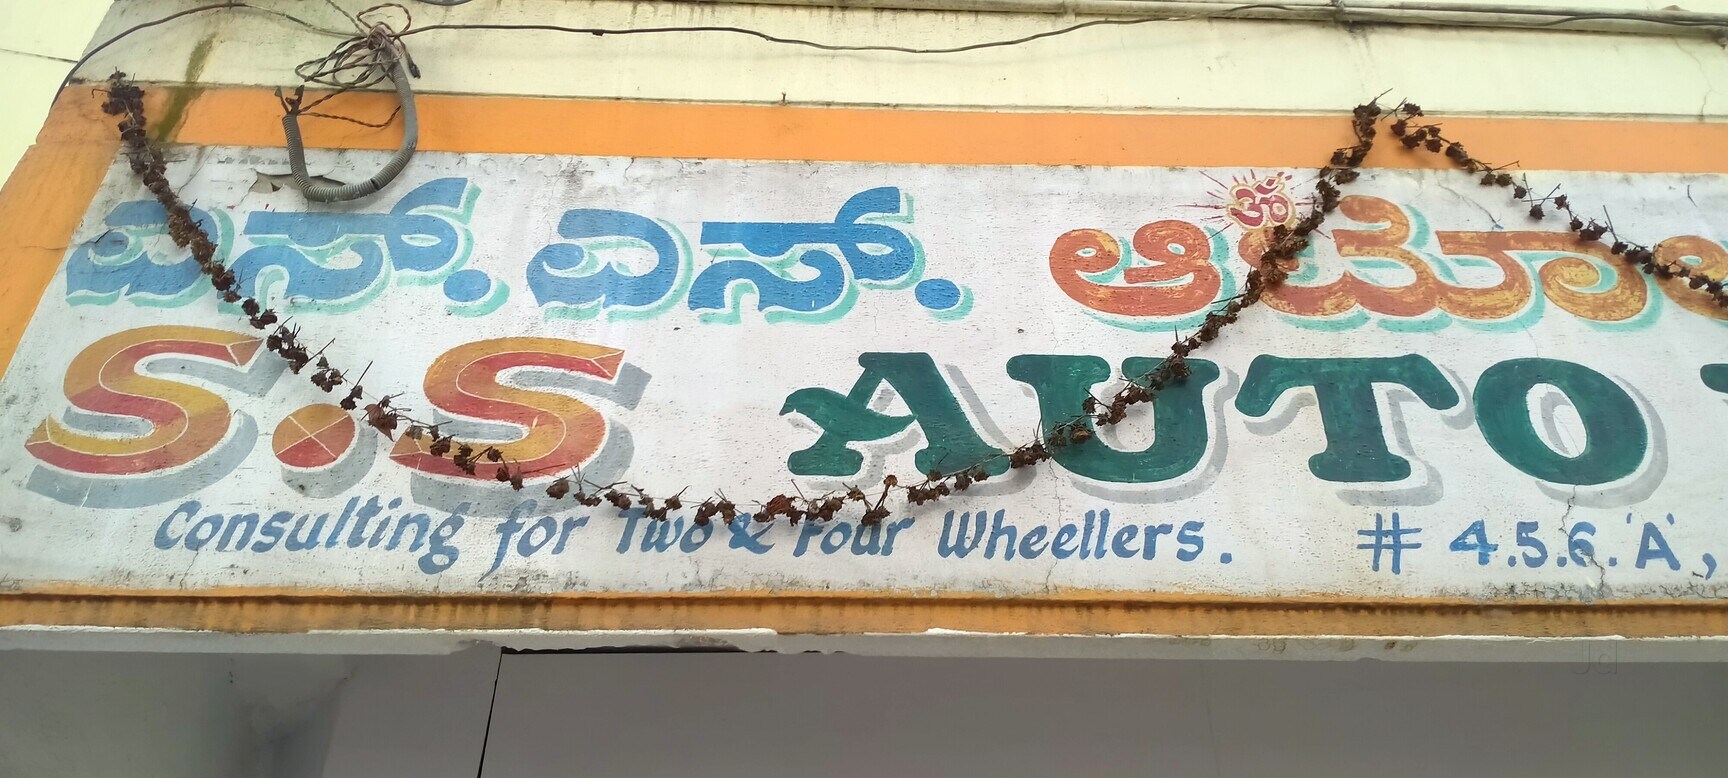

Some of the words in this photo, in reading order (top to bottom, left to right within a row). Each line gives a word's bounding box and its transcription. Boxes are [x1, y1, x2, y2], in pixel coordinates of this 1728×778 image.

[526, 186, 962, 312] ಎಸ್.
[779, 351, 1649, 486] AUTO
[154, 495, 471, 575] Consulting
[478, 498, 590, 582] for
[615, 507, 714, 554] Two
[728, 512, 775, 555] &
[937, 508, 1234, 565] Wheellers.
